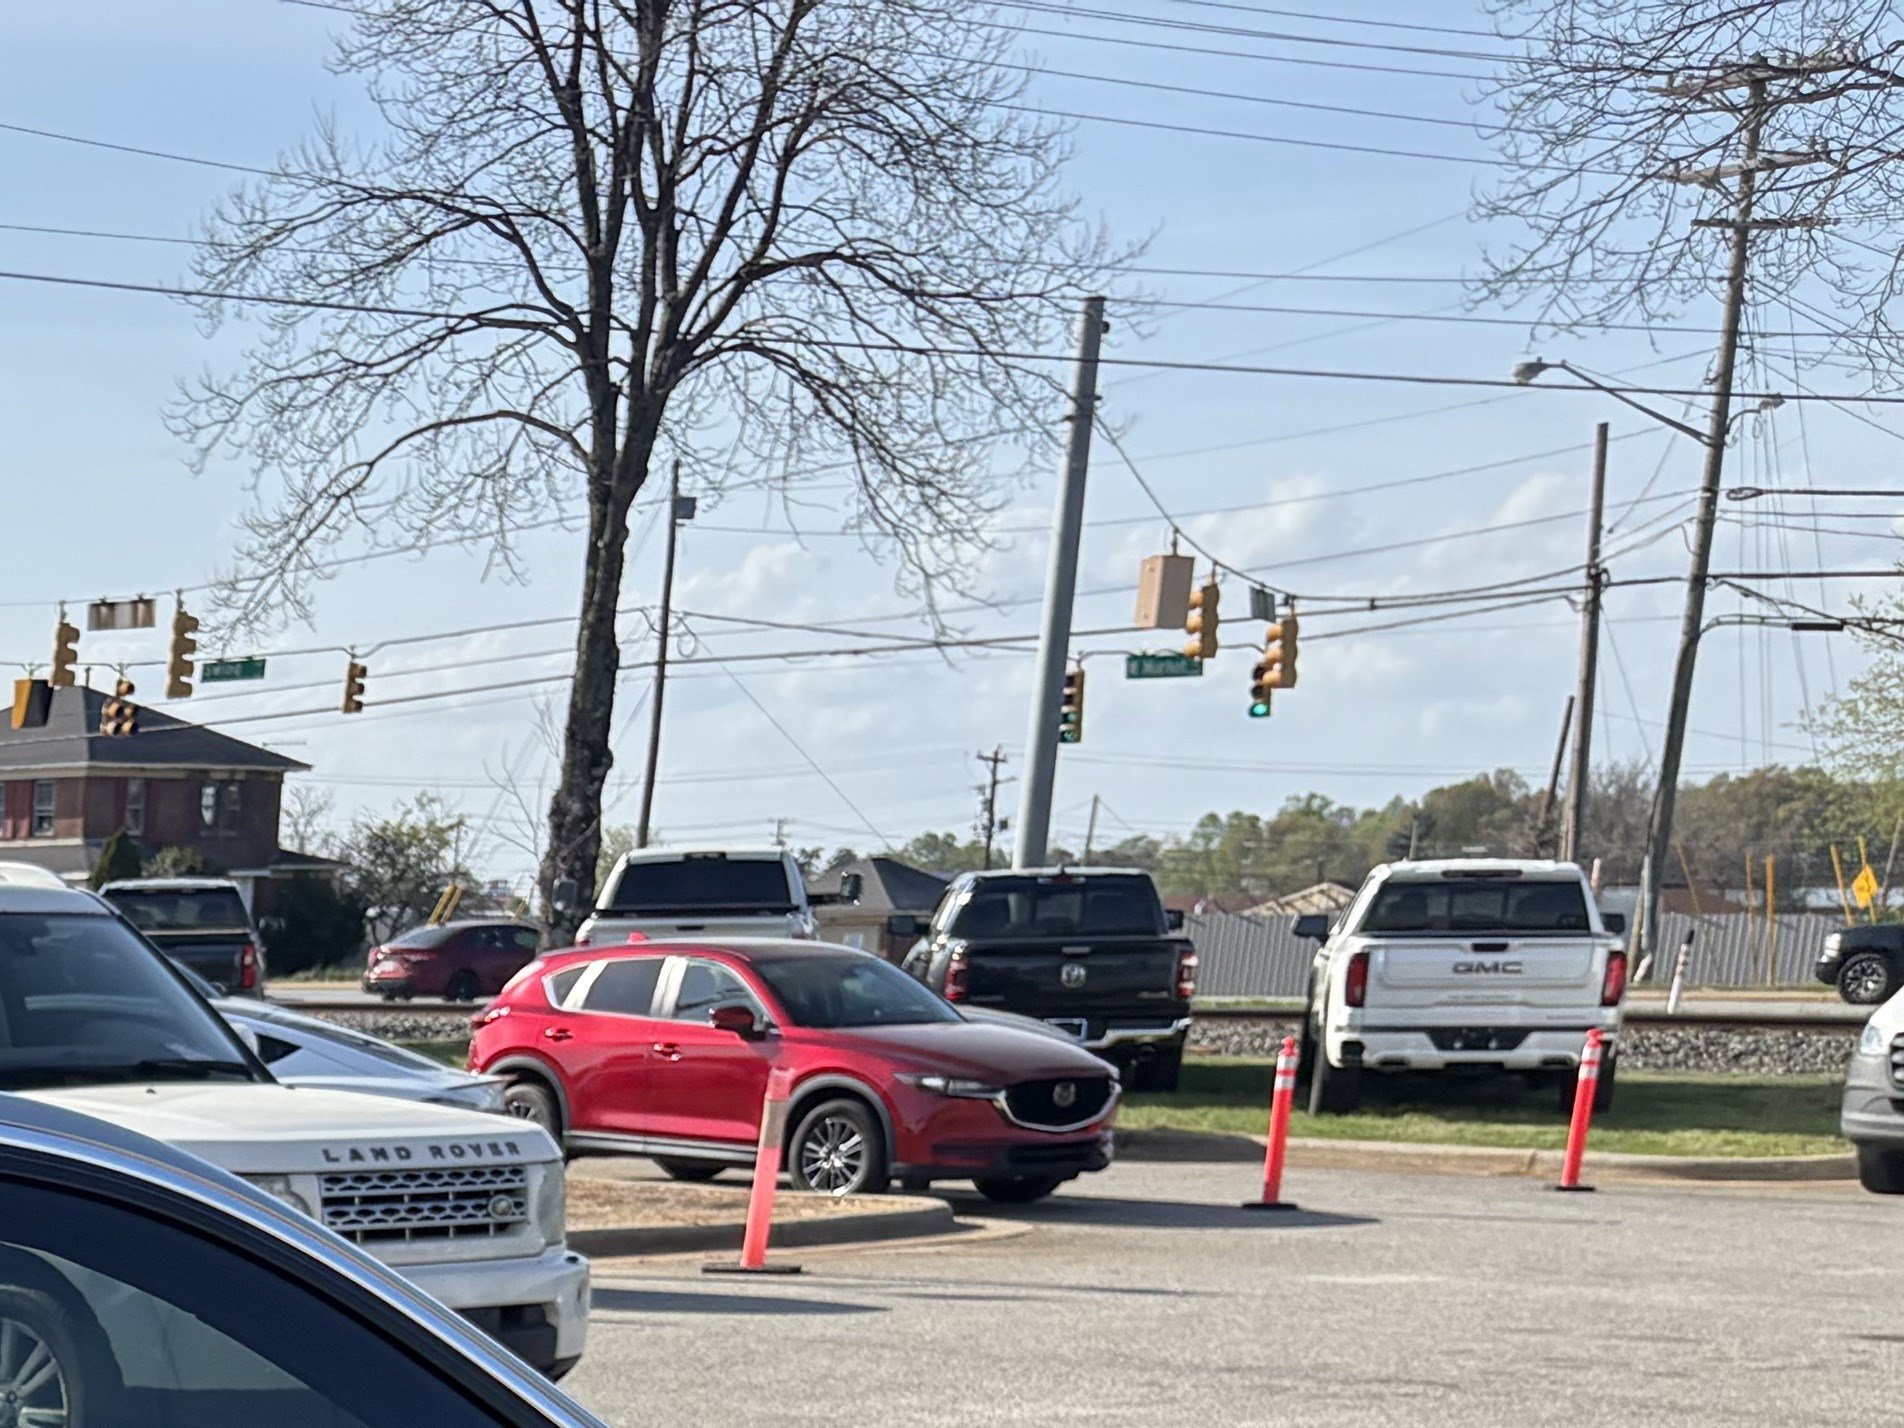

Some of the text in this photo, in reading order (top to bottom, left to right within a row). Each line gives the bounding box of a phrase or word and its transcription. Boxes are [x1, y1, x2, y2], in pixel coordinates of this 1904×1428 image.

[1452, 960, 1524, 975] GMC
[322, 1141, 521, 1163] LAND ROVER
